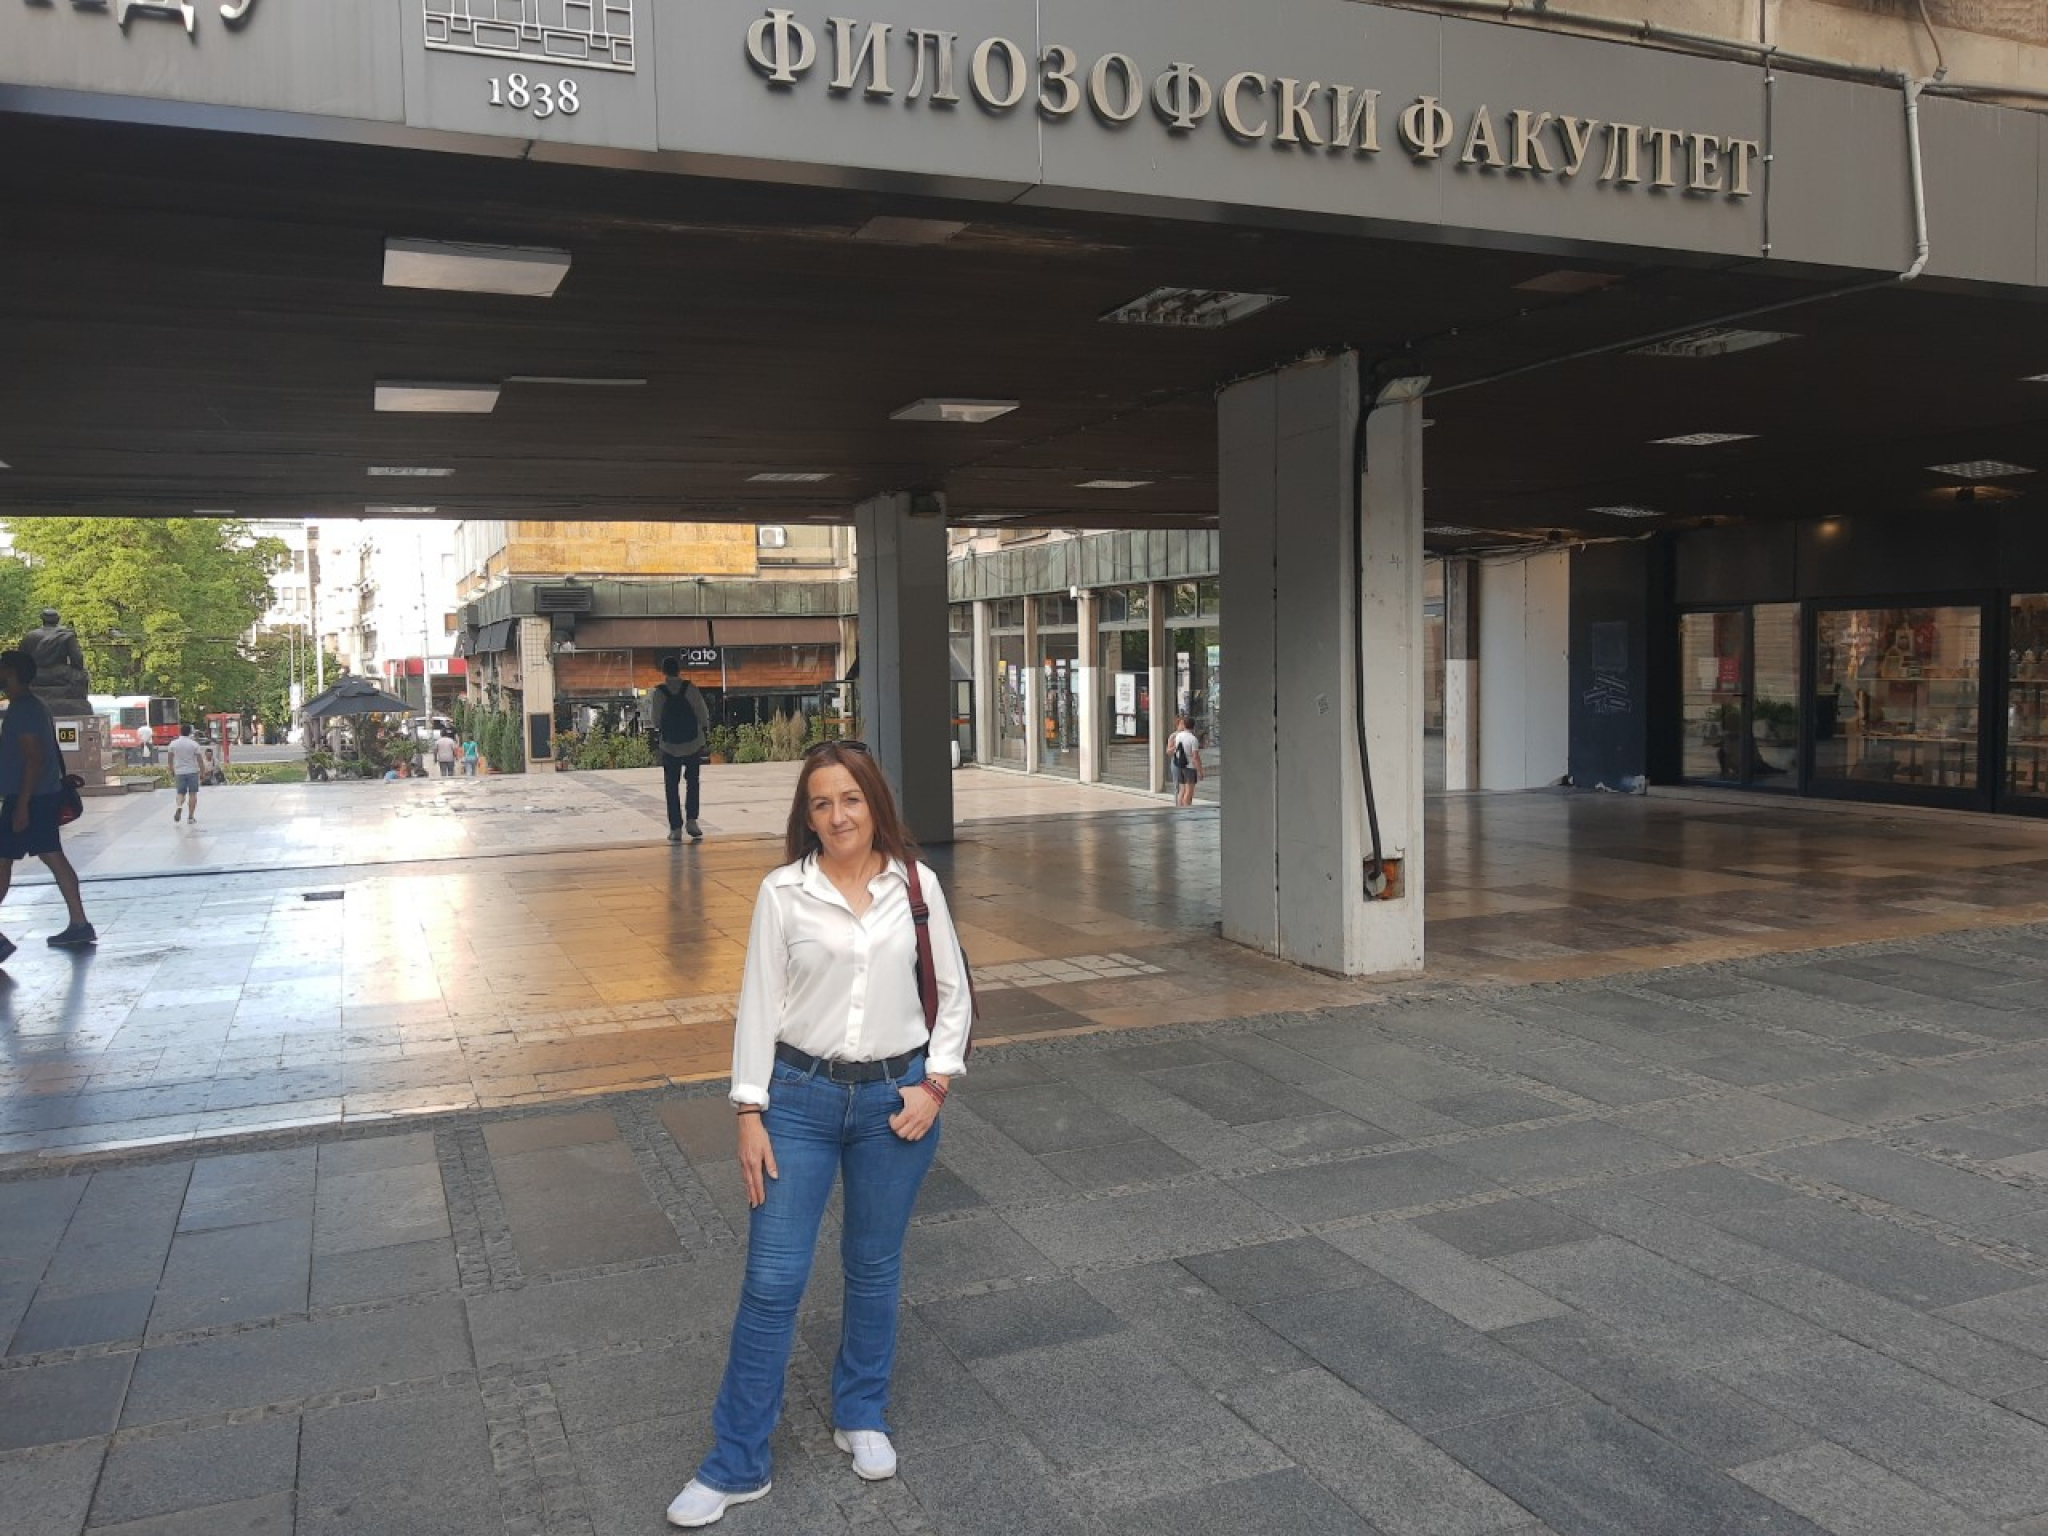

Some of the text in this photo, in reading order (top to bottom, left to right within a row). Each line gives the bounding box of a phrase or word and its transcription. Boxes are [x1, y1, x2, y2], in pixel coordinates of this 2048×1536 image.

[487, 72, 580, 119] 1838
[744, 7, 1759, 197] ФИЛОЗОФСКИ ФАКУЛТЕТ
